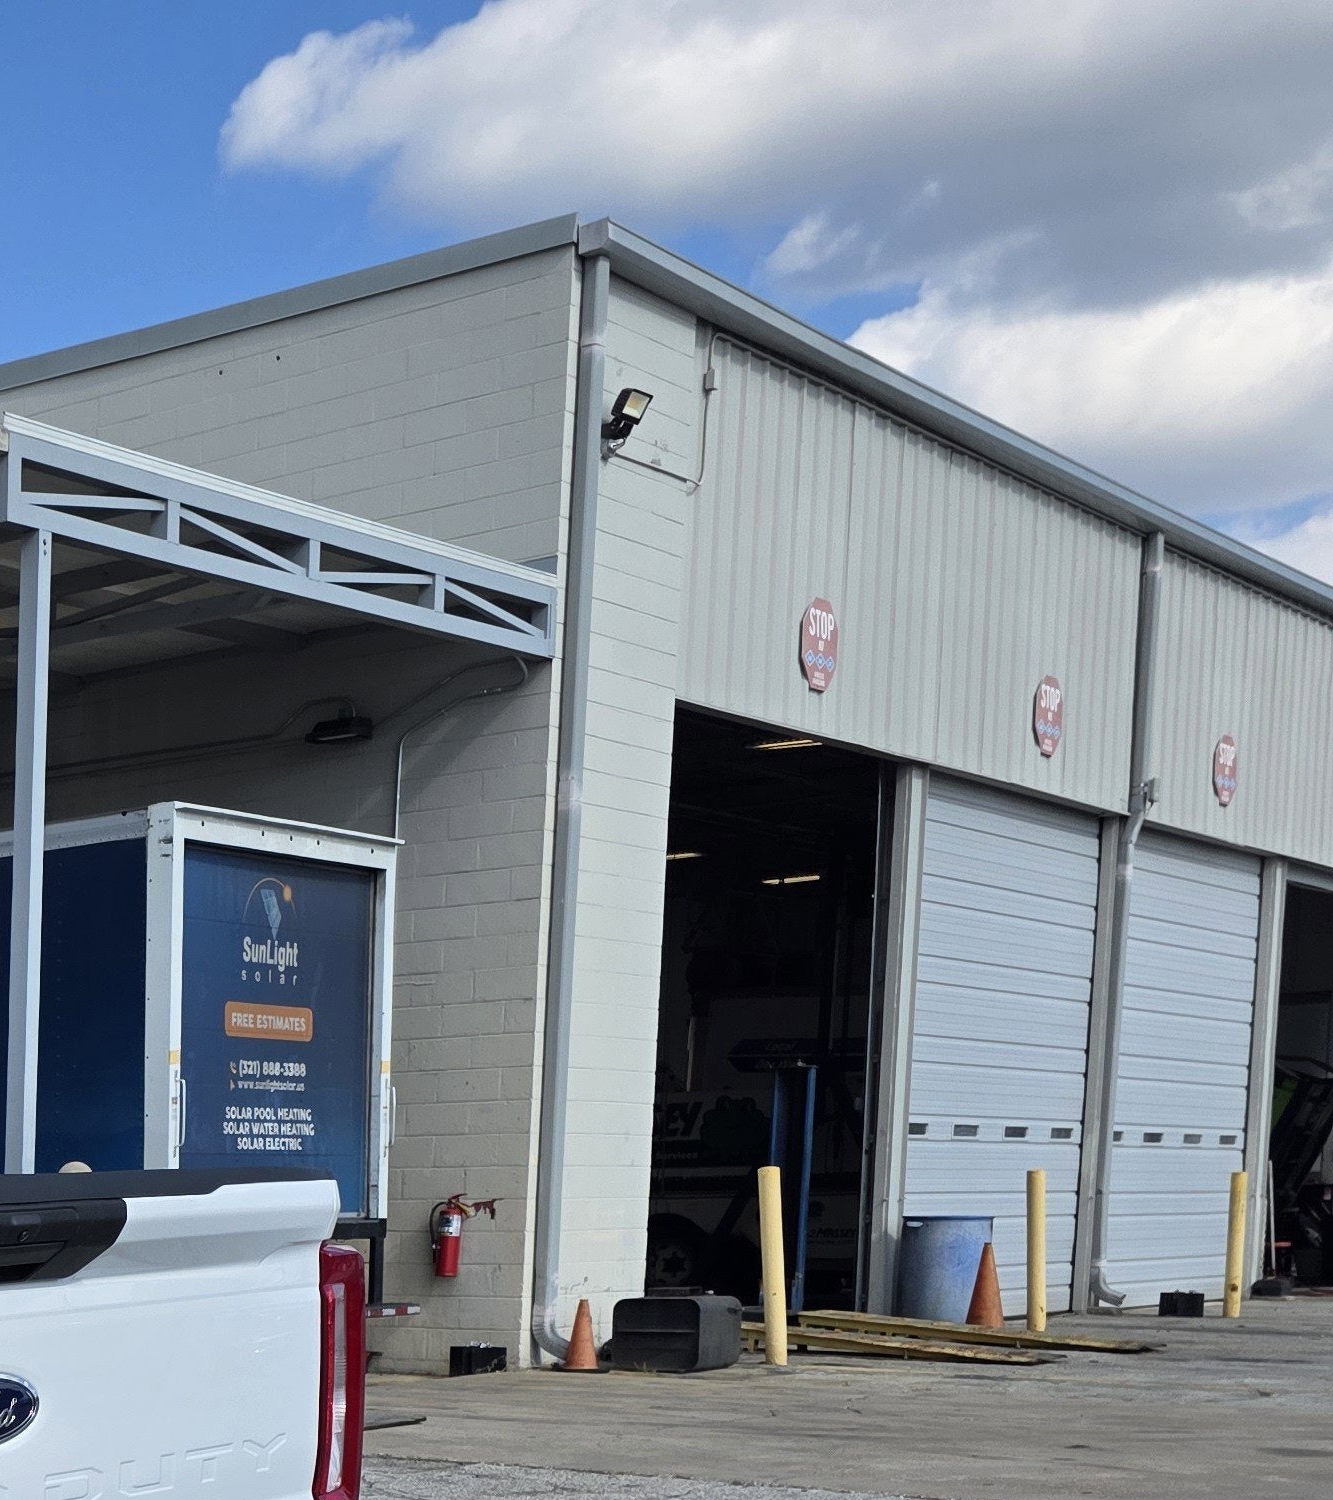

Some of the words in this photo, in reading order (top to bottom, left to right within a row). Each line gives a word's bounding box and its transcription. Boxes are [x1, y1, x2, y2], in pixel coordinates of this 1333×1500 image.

[809, 607, 835, 641] STOP
[1041, 684, 1060, 713] STOP
[242, 936, 298, 972] SunLight
[241, 969, 297, 986] solar
[231, 1012, 254, 1028] FREE
[256, 1014, 306, 1032] ESTIMATES
[239, 1060, 260, 1078] (321)
[263, 1061, 307, 1077] 888-3388
[225, 1106, 252, 1119] SOLAR
[254, 1107, 276, 1120] POOL
[278, 1108, 312, 1121] HEATING
[223, 1122, 250, 1134] SOLAR
[252, 1122, 279, 1135] WATER
[281, 1123, 315, 1136] HEATING
[237, 1137, 264, 1150] SOLAR
[265, 1138, 302, 1151] ELECTRIC
